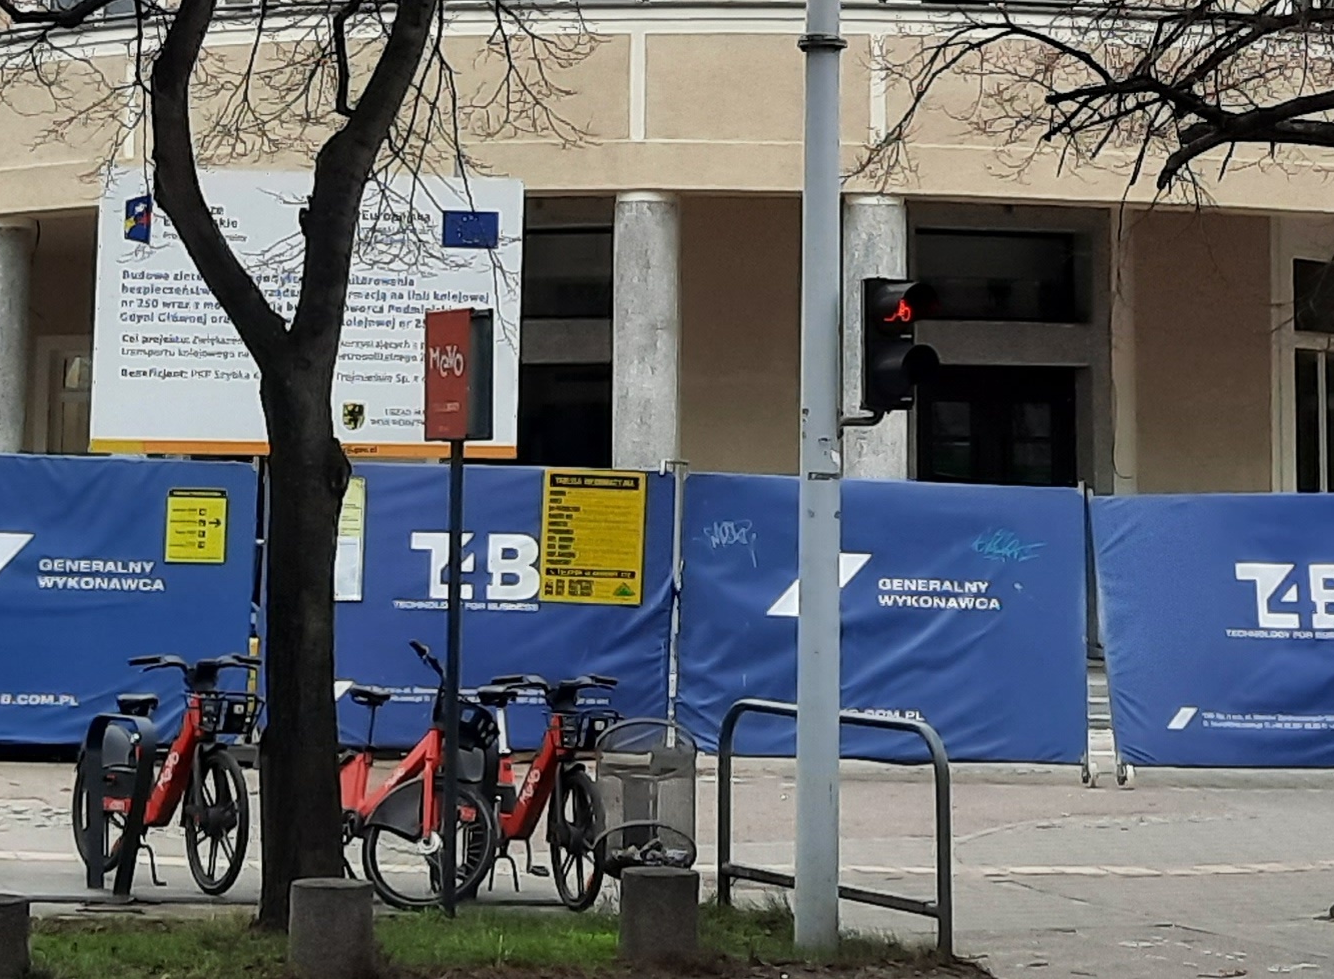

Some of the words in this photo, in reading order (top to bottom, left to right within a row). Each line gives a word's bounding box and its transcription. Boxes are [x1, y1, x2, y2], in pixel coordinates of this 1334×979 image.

[38, 558, 155, 574] GENERALNY
[37, 575, 165, 592] WYKONAWCA
[878, 577, 989, 593] GENERALNY
[878, 594, 1001, 611] WYKONAWCA
